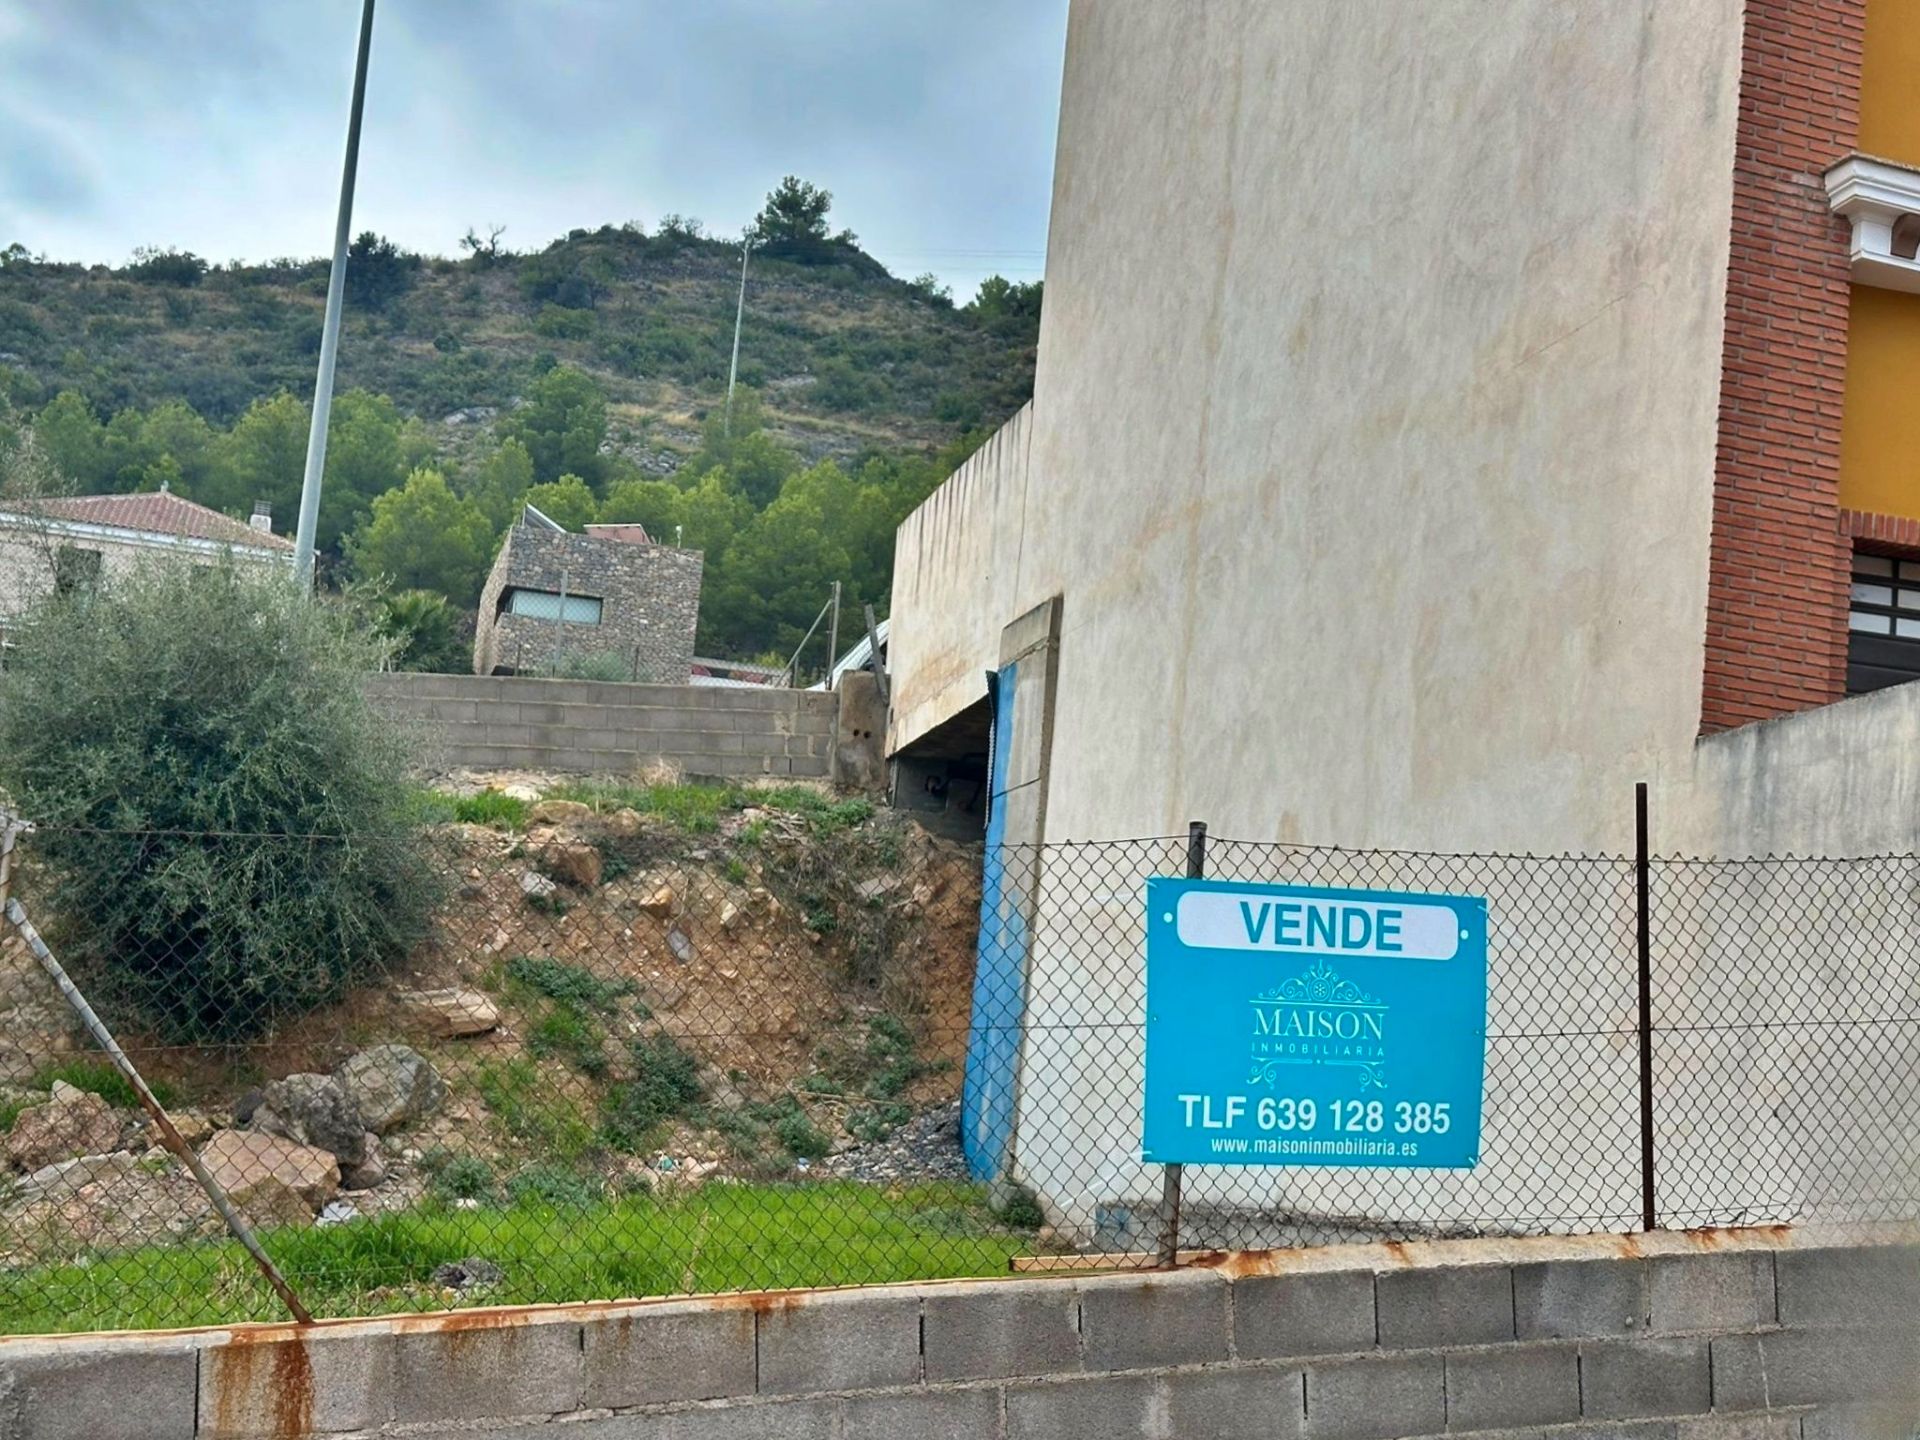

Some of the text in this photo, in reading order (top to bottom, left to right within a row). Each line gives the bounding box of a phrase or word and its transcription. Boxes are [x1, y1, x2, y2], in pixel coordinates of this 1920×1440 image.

[1240, 901, 1403, 952] VENDE
[1252, 1007, 1384, 1040] MAISON
[1251, 1042, 1385, 1057] INMOBILIARIA
[1178, 1094, 1451, 1134] TLF 639 128 385
[1211, 1137, 1418, 1157] www.maisoninmobiliaria.es
